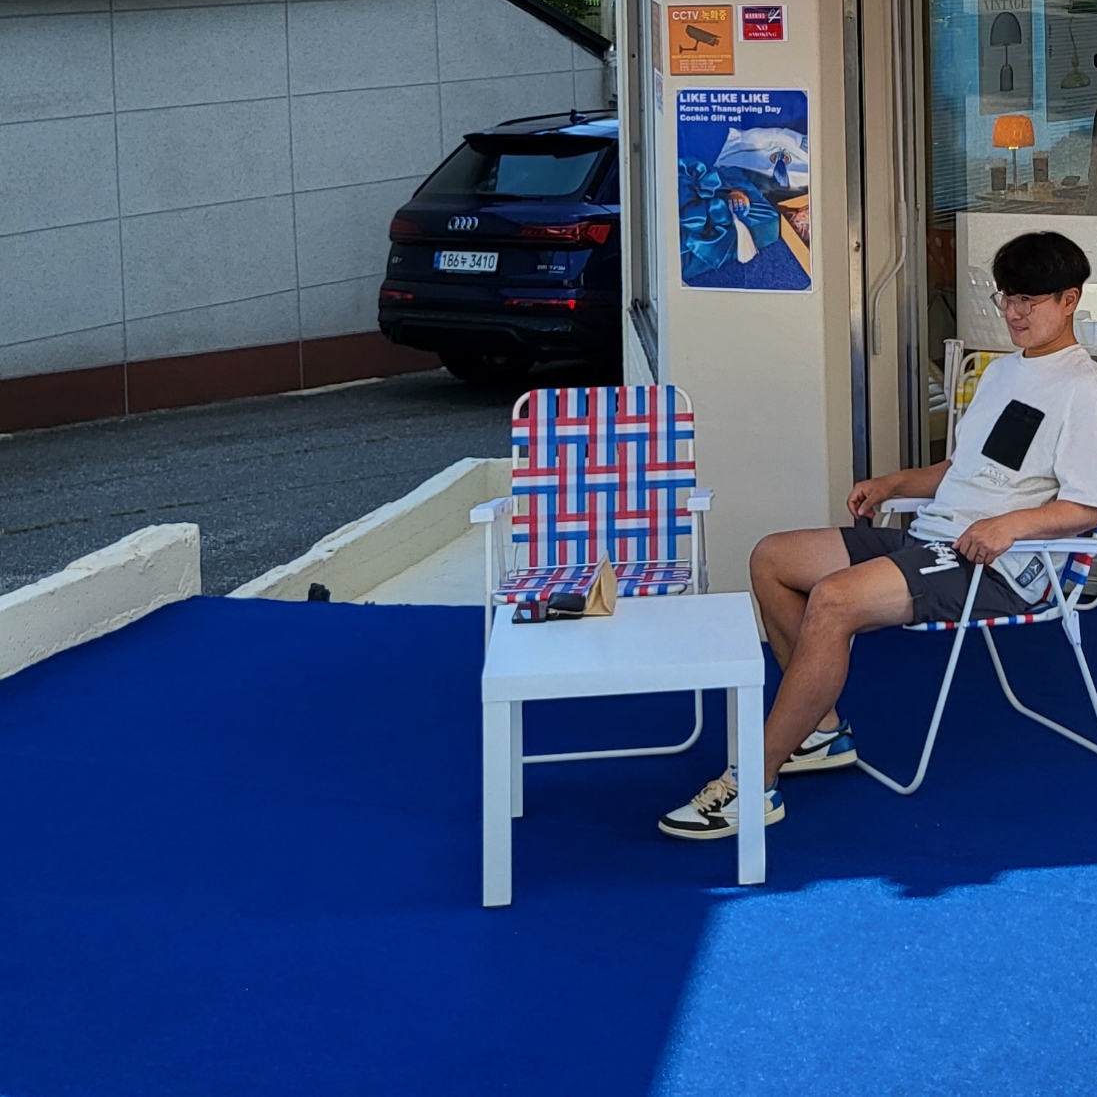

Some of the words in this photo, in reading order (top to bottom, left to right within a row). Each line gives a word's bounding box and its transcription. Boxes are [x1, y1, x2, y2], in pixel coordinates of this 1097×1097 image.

[672, 10, 699, 21] CCTV
[702, 9, 727, 21] 녹화중
[680, 93, 707, 103] LIKE
[710, 93, 738, 103] LIKE
[741, 93, 769, 103] LIKE
[711, 105, 763, 114] Thansgiving
[765, 105, 781, 114] Day
[680, 114, 708, 122] Cookie
[711, 114, 726, 122] Gift
[442, 253, 467, 268] 186누
[469, 254, 496, 269] 3410
